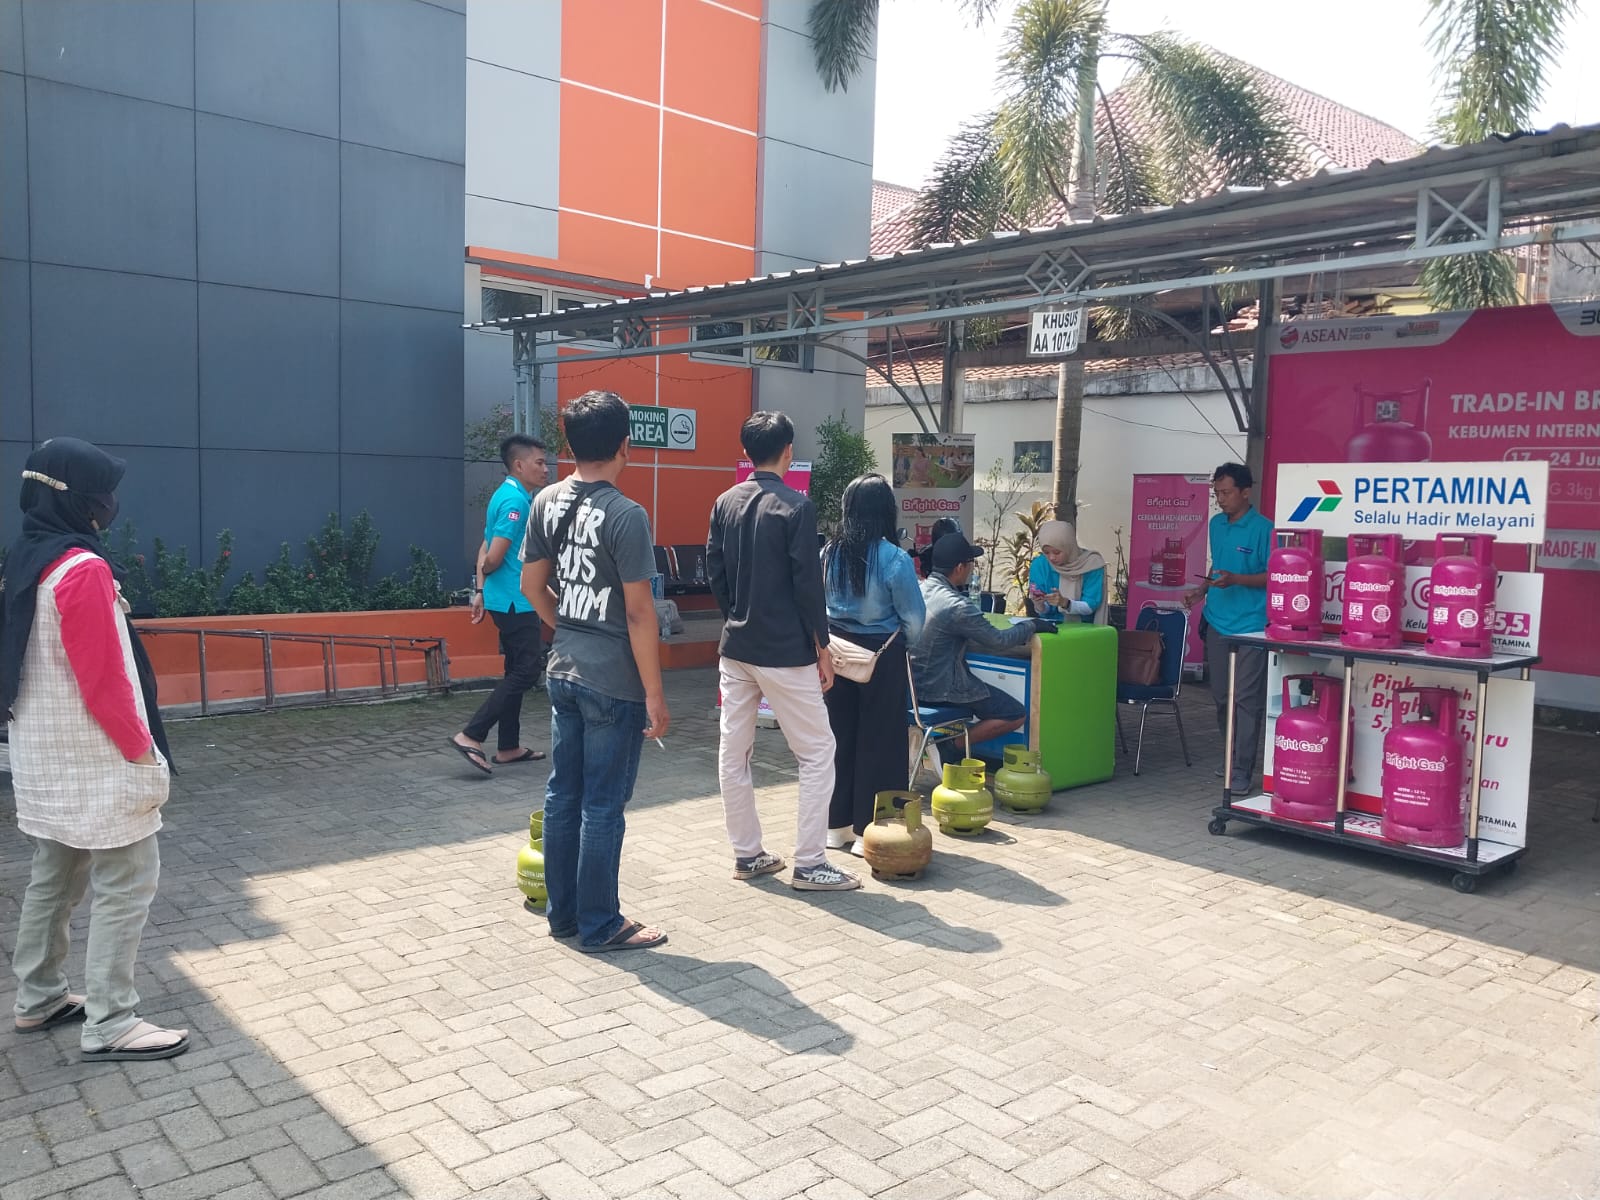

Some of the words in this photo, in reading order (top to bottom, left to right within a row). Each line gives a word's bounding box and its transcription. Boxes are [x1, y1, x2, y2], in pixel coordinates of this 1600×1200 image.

[1042, 311, 1078, 329] KHUSUS
[1033, 333, 1048, 352] AA
[1301, 327, 1349, 343] ASEAN
[1450, 390, 1565, 413] TRADE-IN
[629, 409, 666, 423] MOKING
[1448, 424, 1530, 439] KEBUMEN
[1549, 452, 1571, 466] 24
[1354, 477, 1531, 505] PERTAMINA
[1567, 481, 1593, 500] 3kg
[902, 497, 936, 512] Bright
[938, 499, 961, 511] Gas
[1146, 497, 1172, 508] Bright
[1173, 498, 1190, 507] Gas
[1354, 510, 1400, 524] Selalu
[1406, 511, 1451, 526] Hadir
[1455, 512, 1535, 530] Melayani
[1460, 725, 1509, 747] bru
[1299, 740, 1323, 752] Gas
[1386, 751, 1417, 770] Bright
[1418, 758, 1445, 771] Gas
